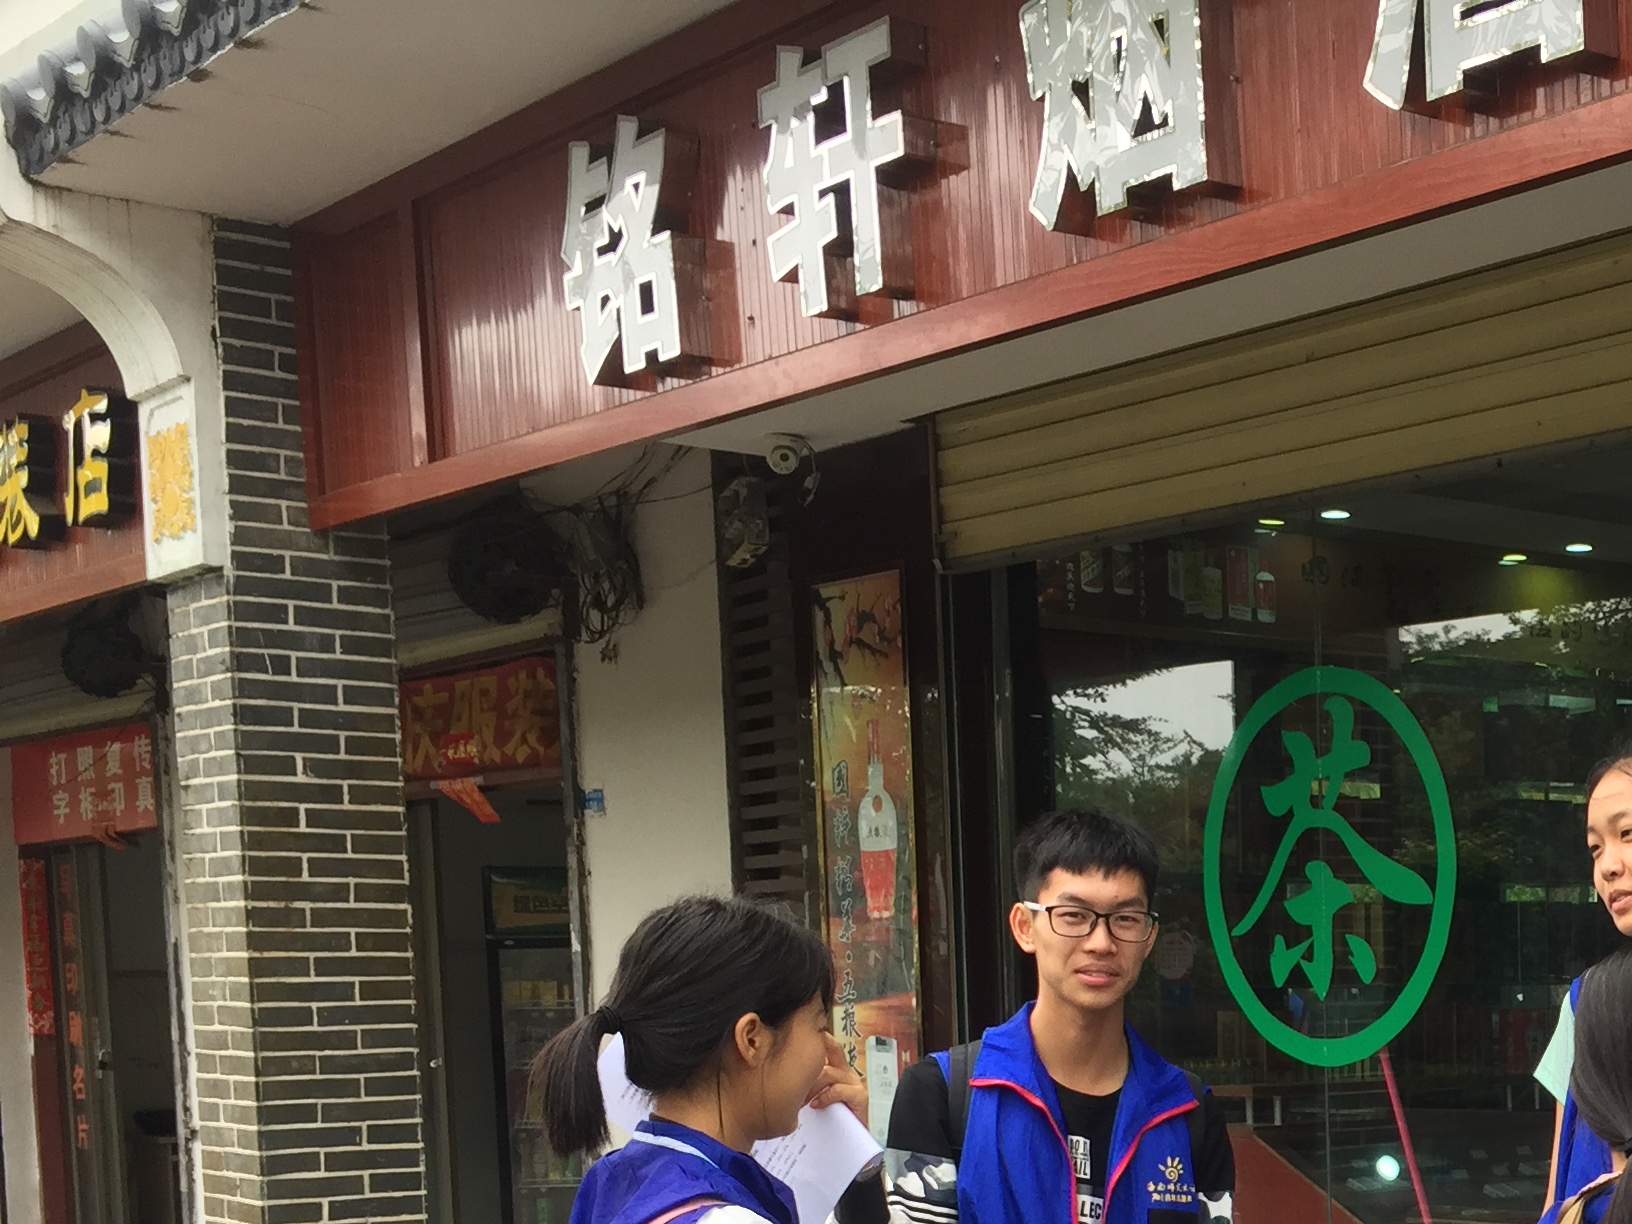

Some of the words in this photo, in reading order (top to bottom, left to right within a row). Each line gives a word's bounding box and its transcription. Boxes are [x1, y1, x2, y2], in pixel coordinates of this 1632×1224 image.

[562, 0, 1588, 386] 铭轩烟
[1231, 696, 1434, 1001] 茶
